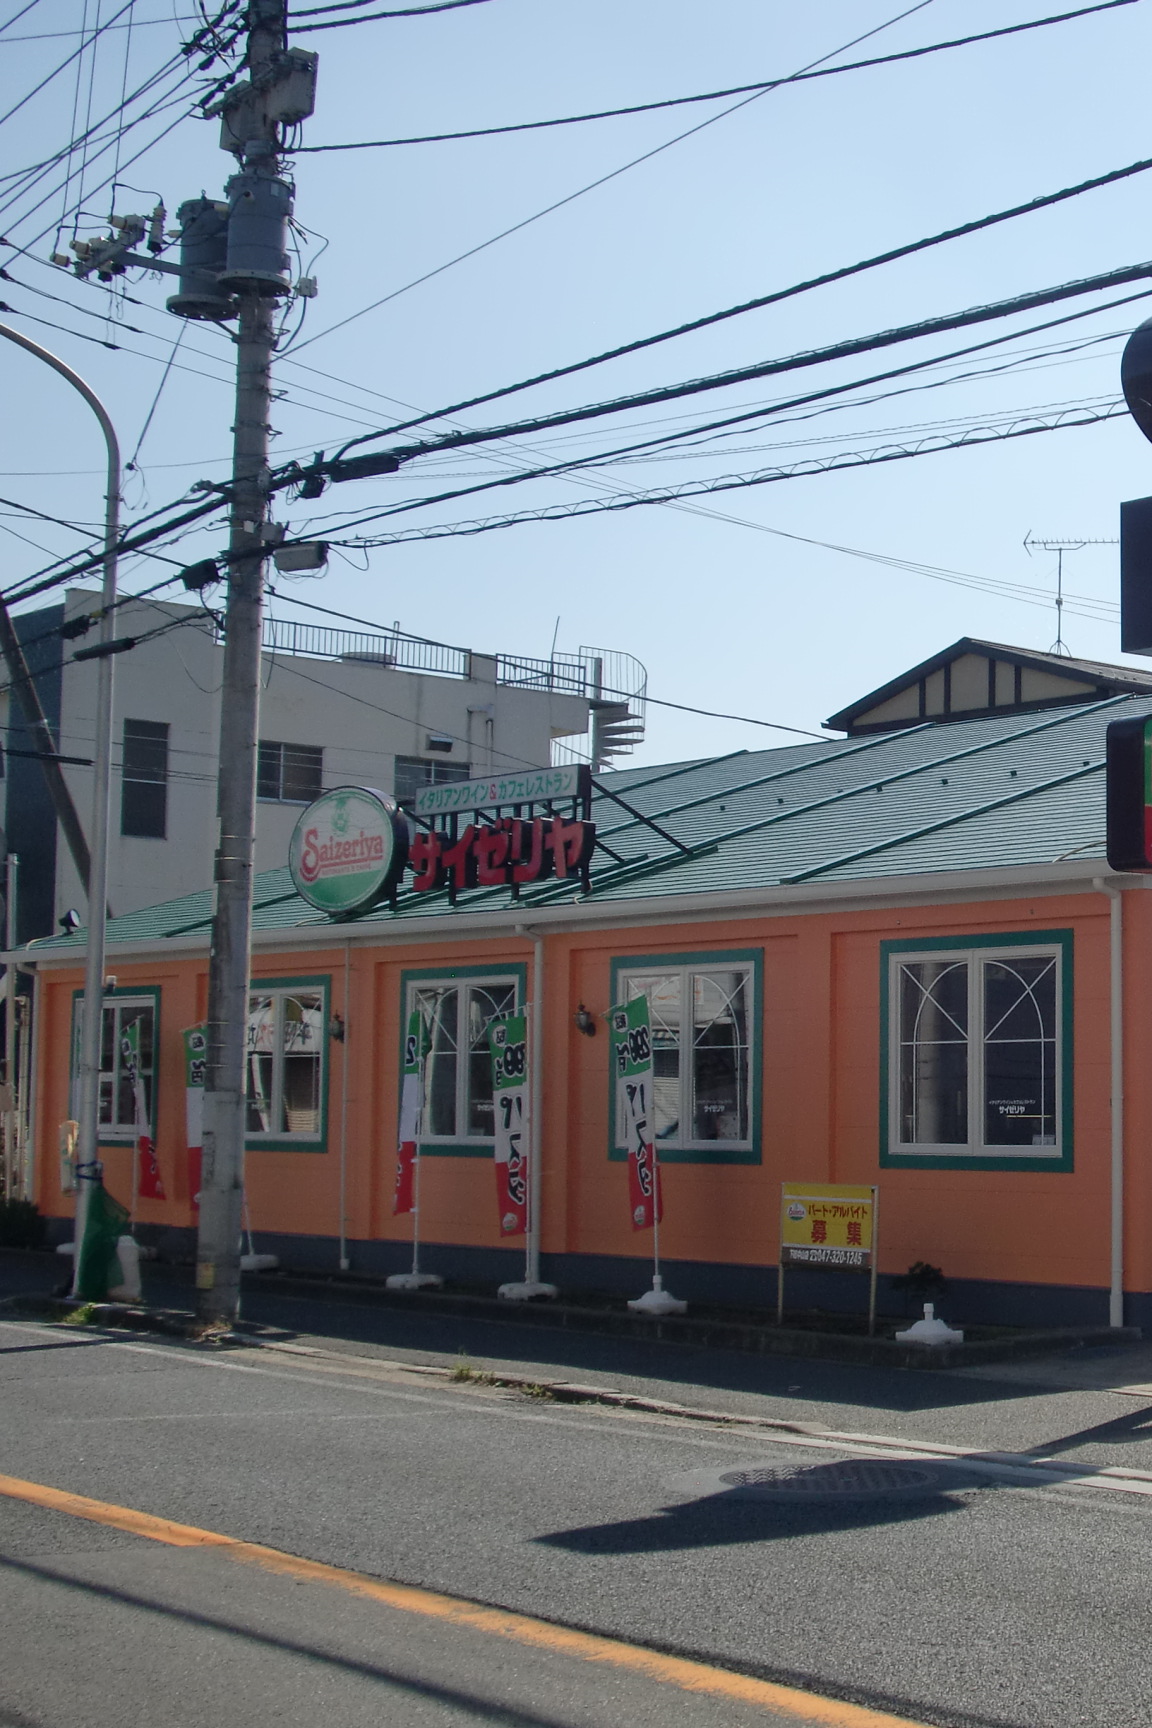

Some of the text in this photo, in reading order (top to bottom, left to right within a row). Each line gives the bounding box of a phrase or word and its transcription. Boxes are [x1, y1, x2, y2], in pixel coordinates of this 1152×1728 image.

[300, 828, 384, 882] Saizeriya
[408, 816, 587, 893] サイゼリヤ
[999, 1105, 1026, 1114] サイゼリヤ
